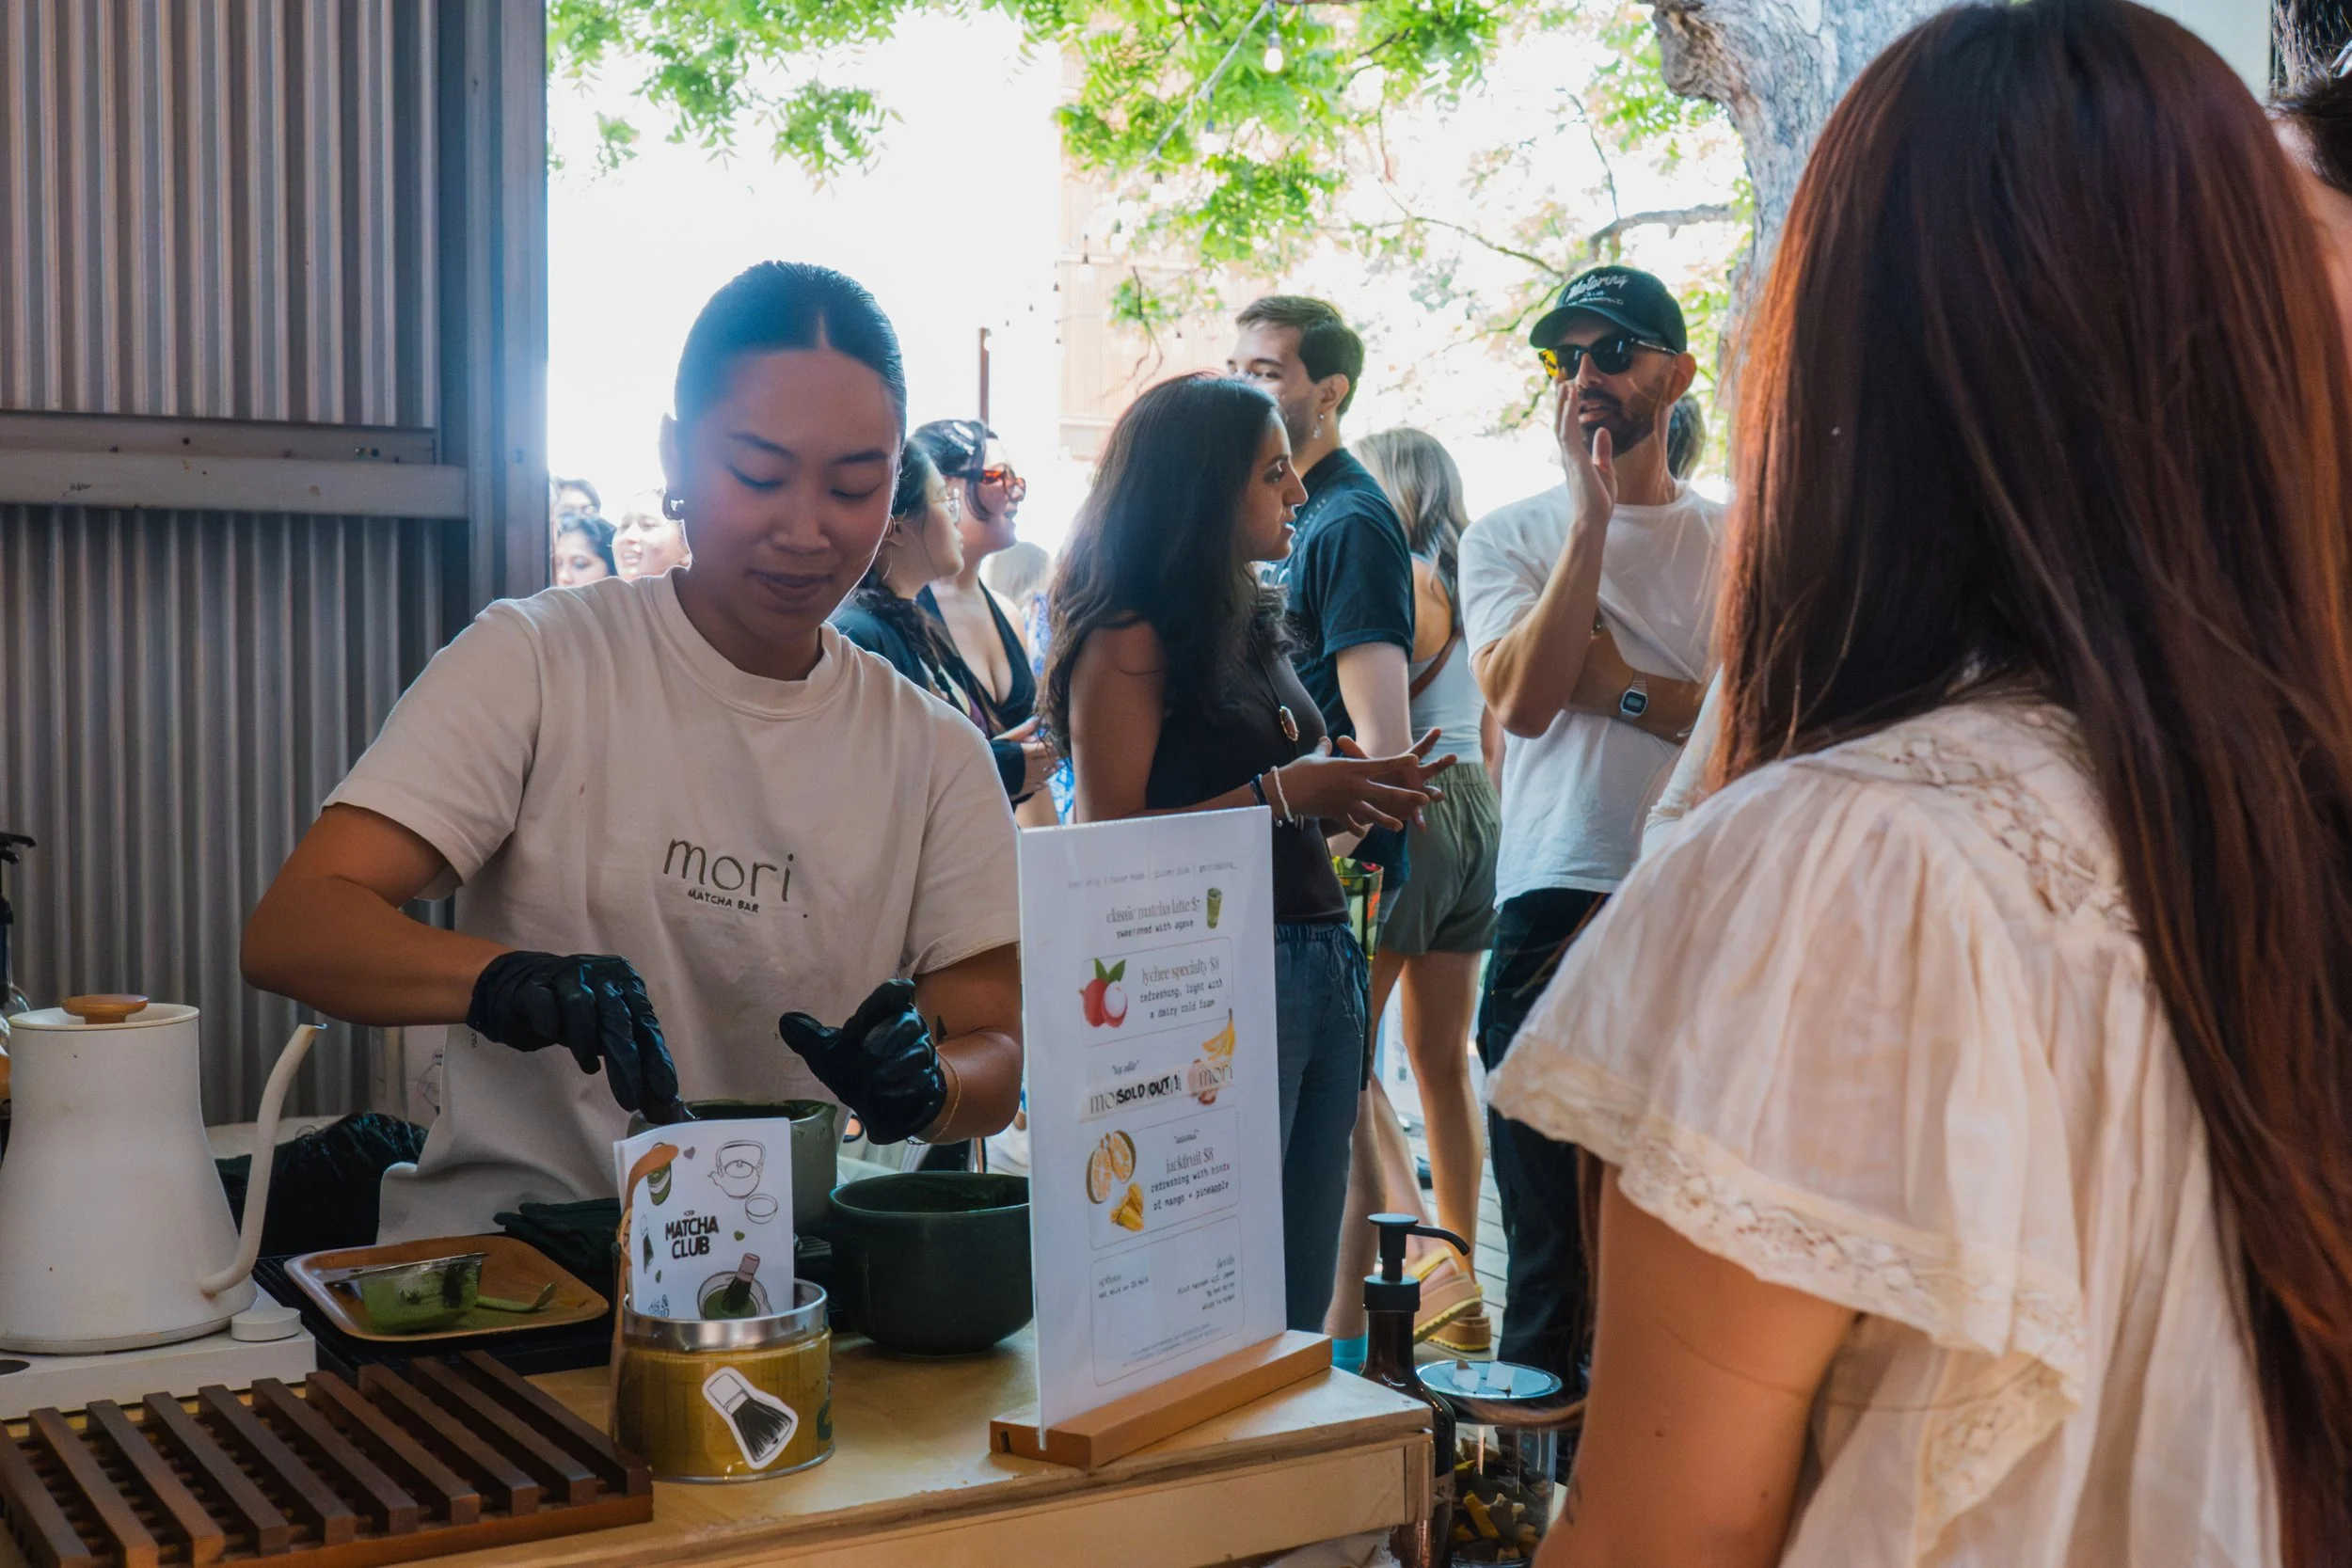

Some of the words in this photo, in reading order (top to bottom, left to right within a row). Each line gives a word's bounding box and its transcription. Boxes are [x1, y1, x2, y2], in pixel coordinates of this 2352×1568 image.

[1565, 274, 1629, 303] Motoring
[663, 838, 794, 902] mori
[687, 889, 733, 908] MATCHA
[738, 899, 760, 913] BAR
[1106, 906, 1135, 924] classic
[1137, 900, 1170, 920] matcha
[1171, 898, 1190, 915] latte
[1155, 921, 1172, 933] with
[1142, 965, 1169, 986] lychee
[1170, 958, 1208, 981] specialty
[1207, 977, 1223, 990] with
[1158, 1006, 1178, 1018] dairy
[1117, 1085, 1145, 1104] SOLD
[1148, 1076, 1170, 1096] OUT
[1167, 1150, 1201, 1177] jackfruit
[1151, 1175, 1190, 1193] refreshing
[1192, 1168, 1209, 1180] with
[1152, 1199, 1162, 1211] of
[1165, 1195, 1184, 1206] mango
[1196, 1180, 1230, 1199] pineapple
[665, 1215, 720, 1241] MATCHA
[672, 1236, 710, 1259] CLUB
